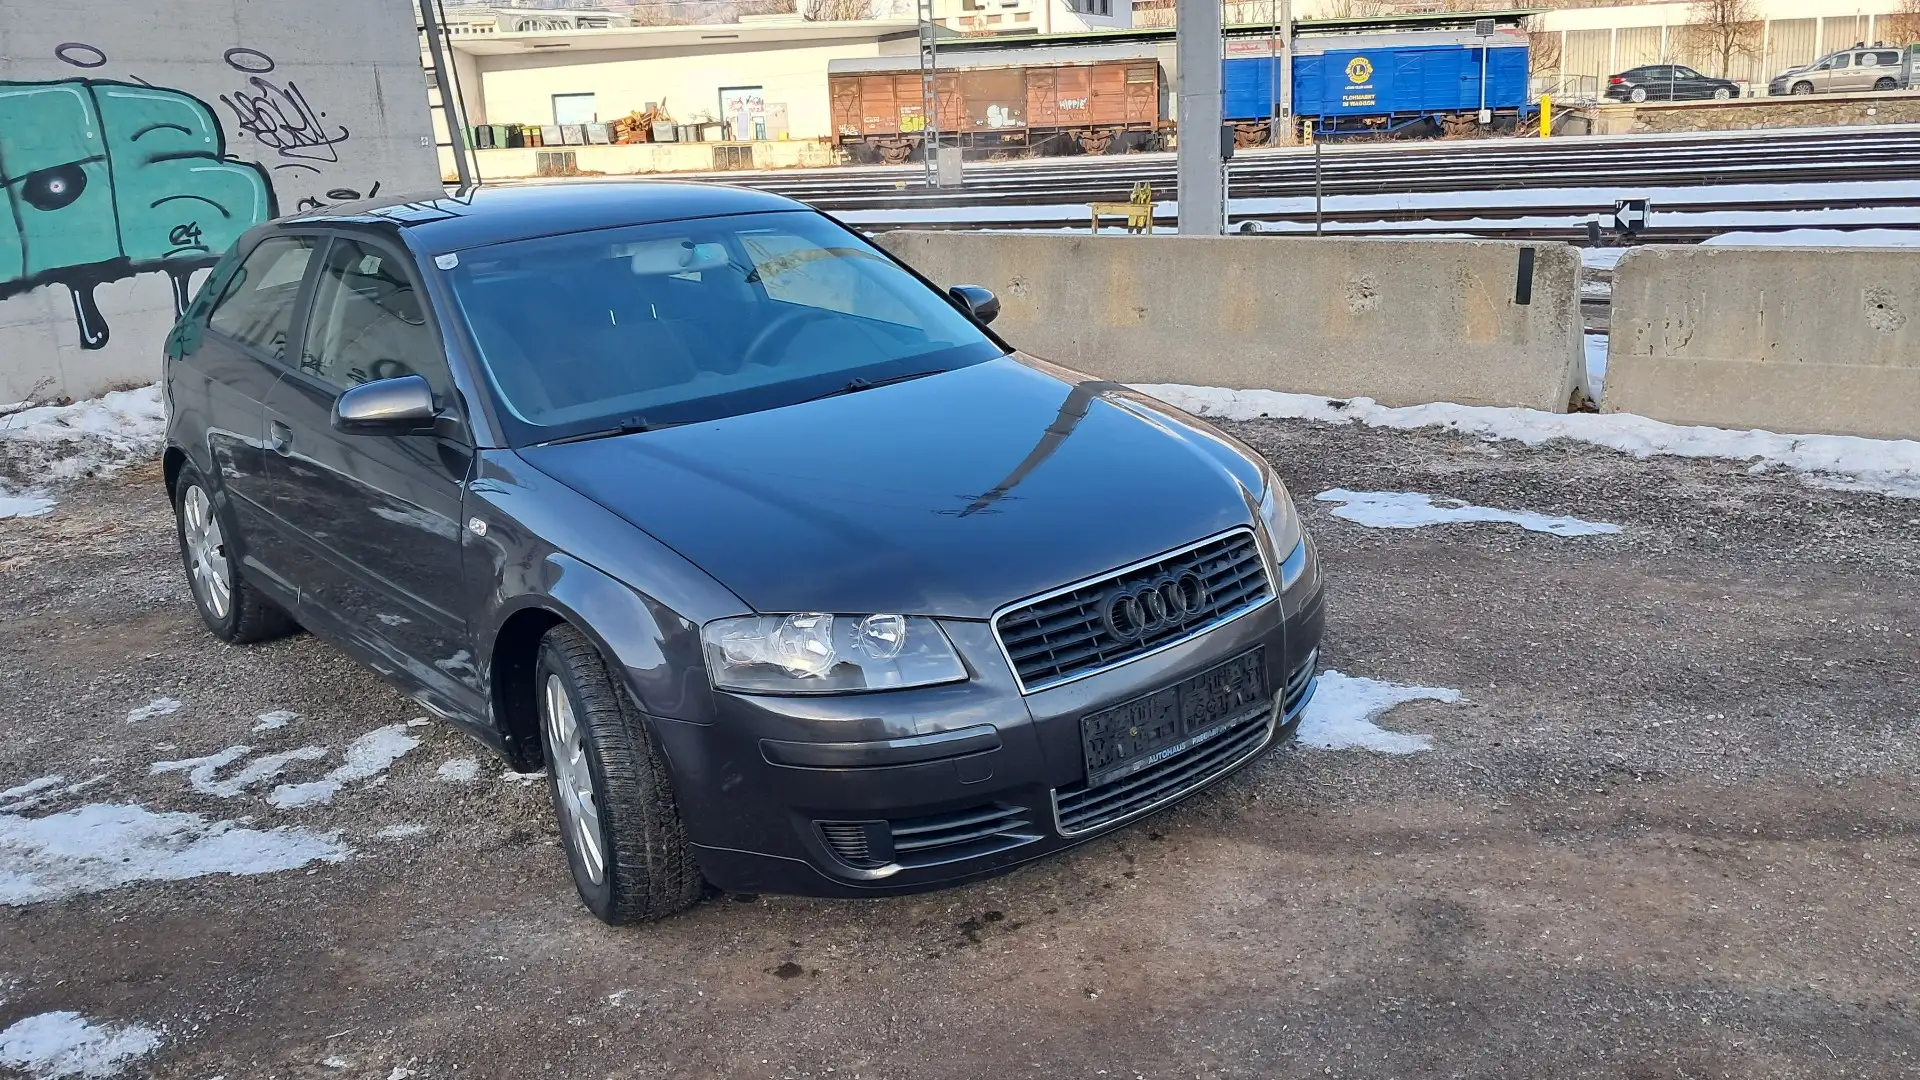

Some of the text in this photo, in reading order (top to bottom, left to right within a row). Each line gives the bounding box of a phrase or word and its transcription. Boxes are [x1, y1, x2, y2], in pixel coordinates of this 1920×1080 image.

[1356, 65, 1363, 75] L
[1616, 200, 1624, 208] 17
[1148, 742, 1186, 764] AUTOHAUS
